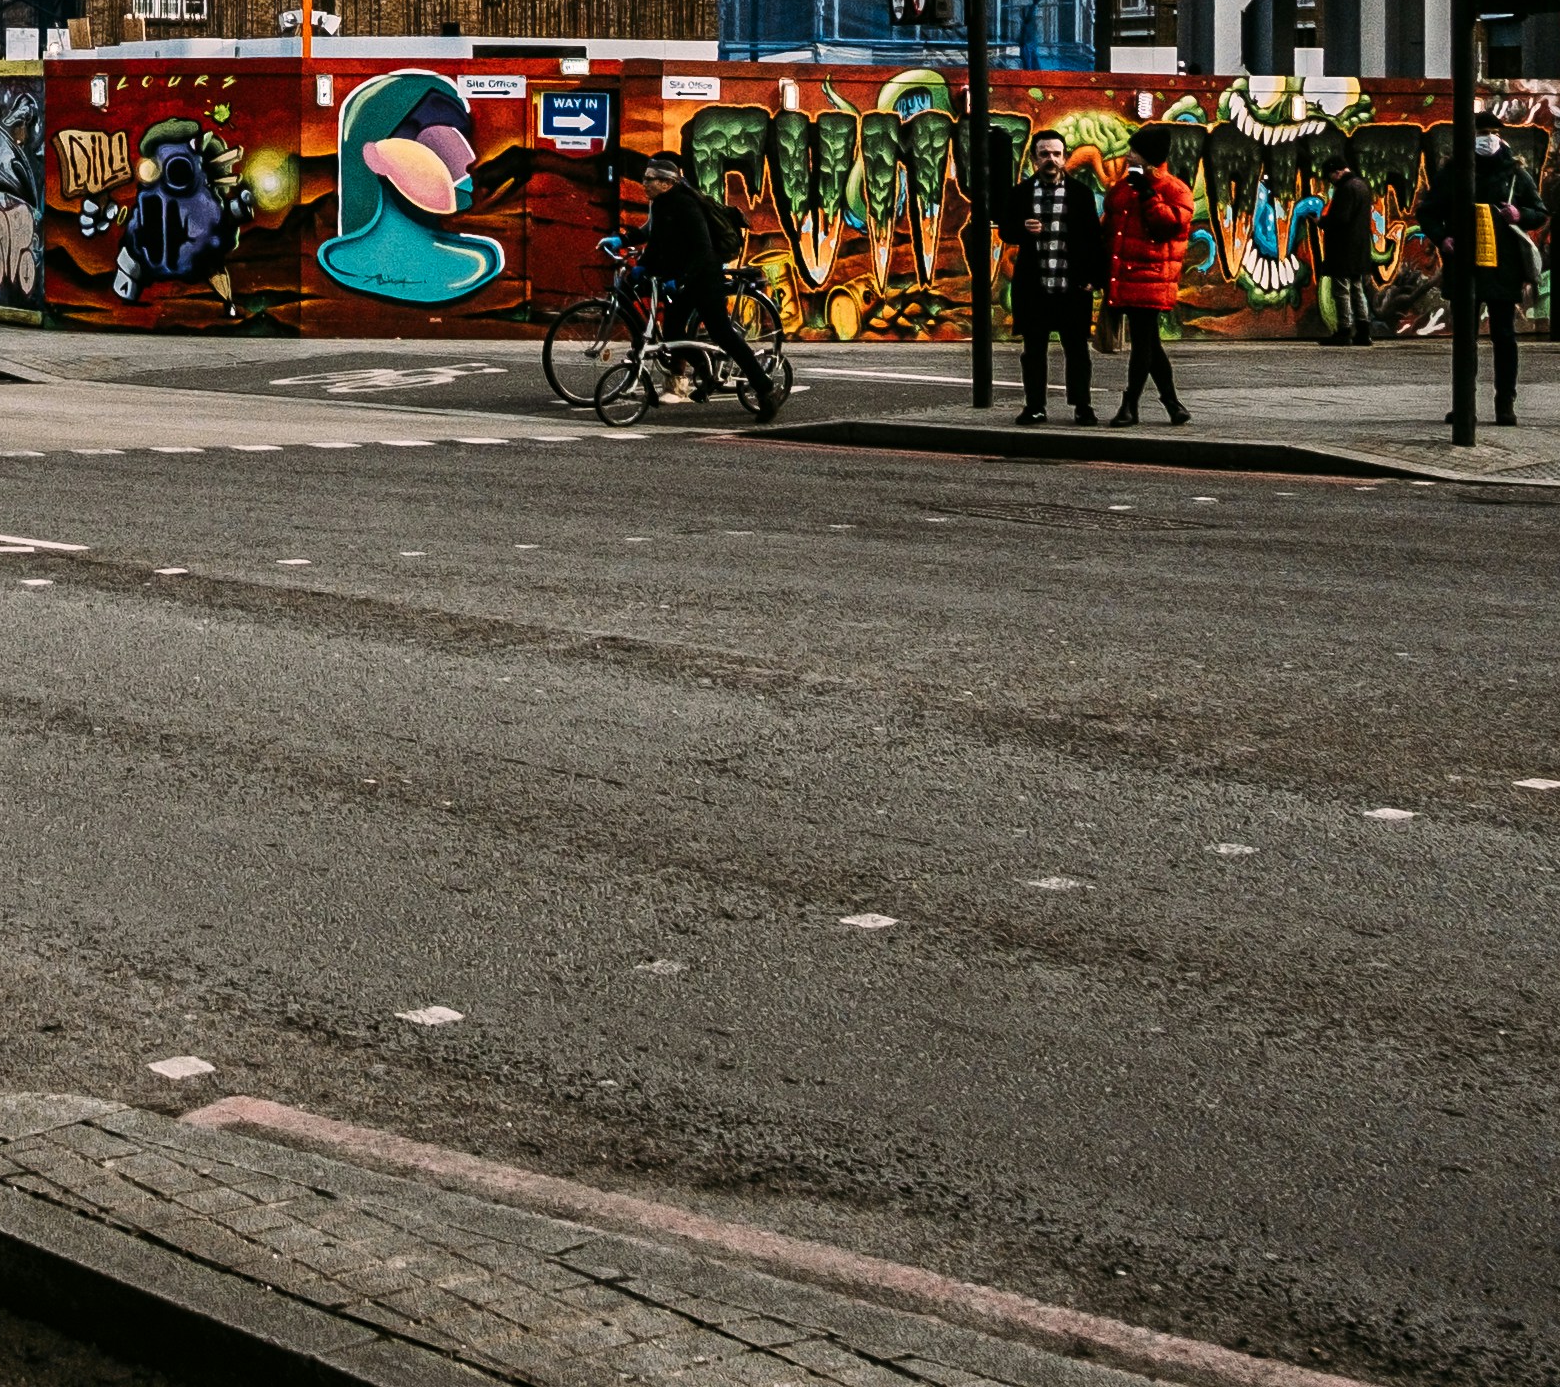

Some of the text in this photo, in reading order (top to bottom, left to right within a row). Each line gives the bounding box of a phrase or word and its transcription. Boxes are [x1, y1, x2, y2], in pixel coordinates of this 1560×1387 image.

[466, 79, 518, 88] Site Office
[553, 97, 598, 109] WAY IN
